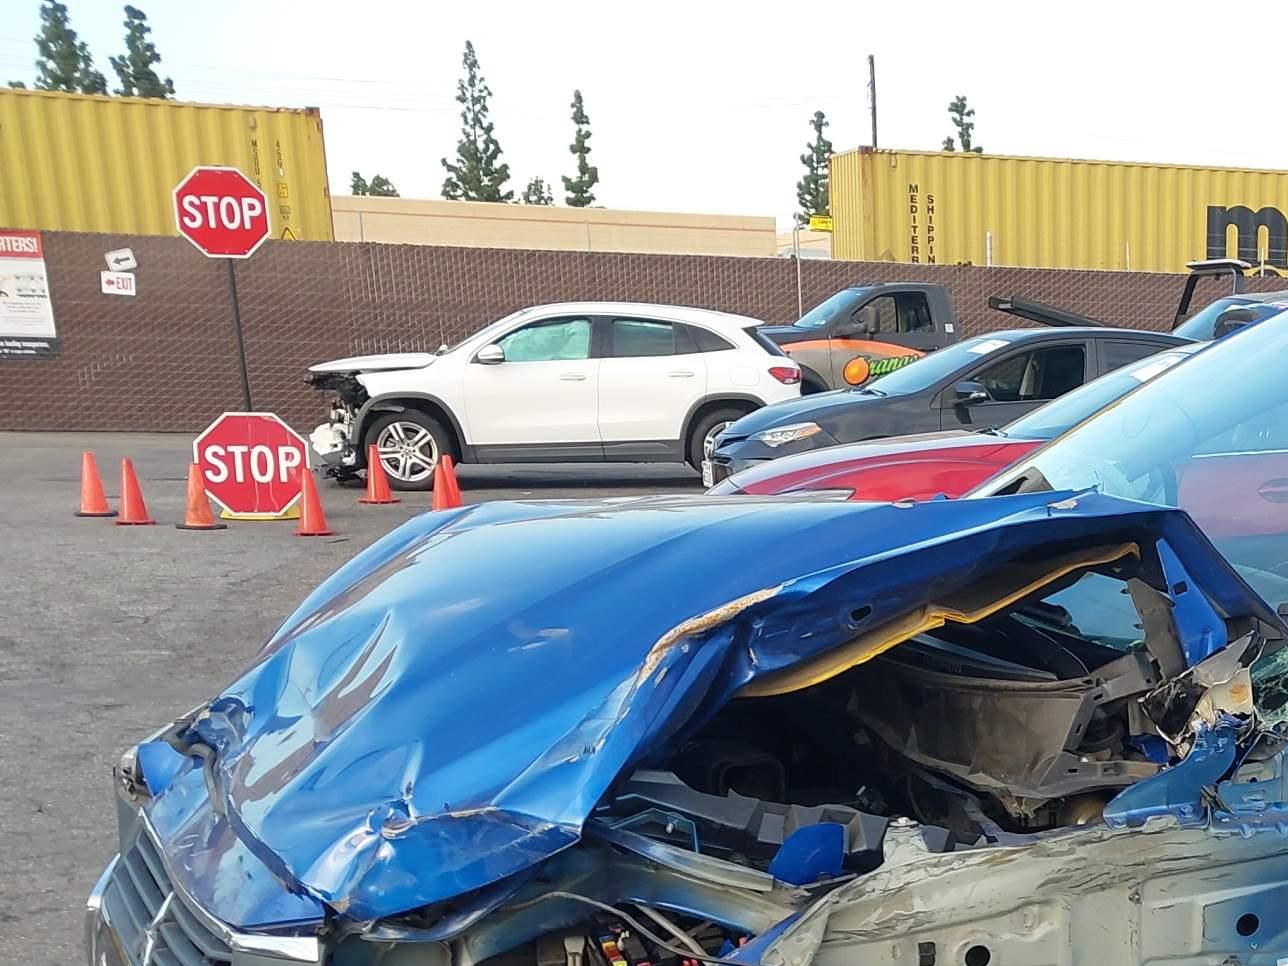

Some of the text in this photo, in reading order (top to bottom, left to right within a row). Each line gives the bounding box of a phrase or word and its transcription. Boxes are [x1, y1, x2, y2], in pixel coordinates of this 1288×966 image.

[182, 195, 262, 230] STOP
[115, 276, 132, 291] EXIT
[204, 445, 302, 484] STOP
